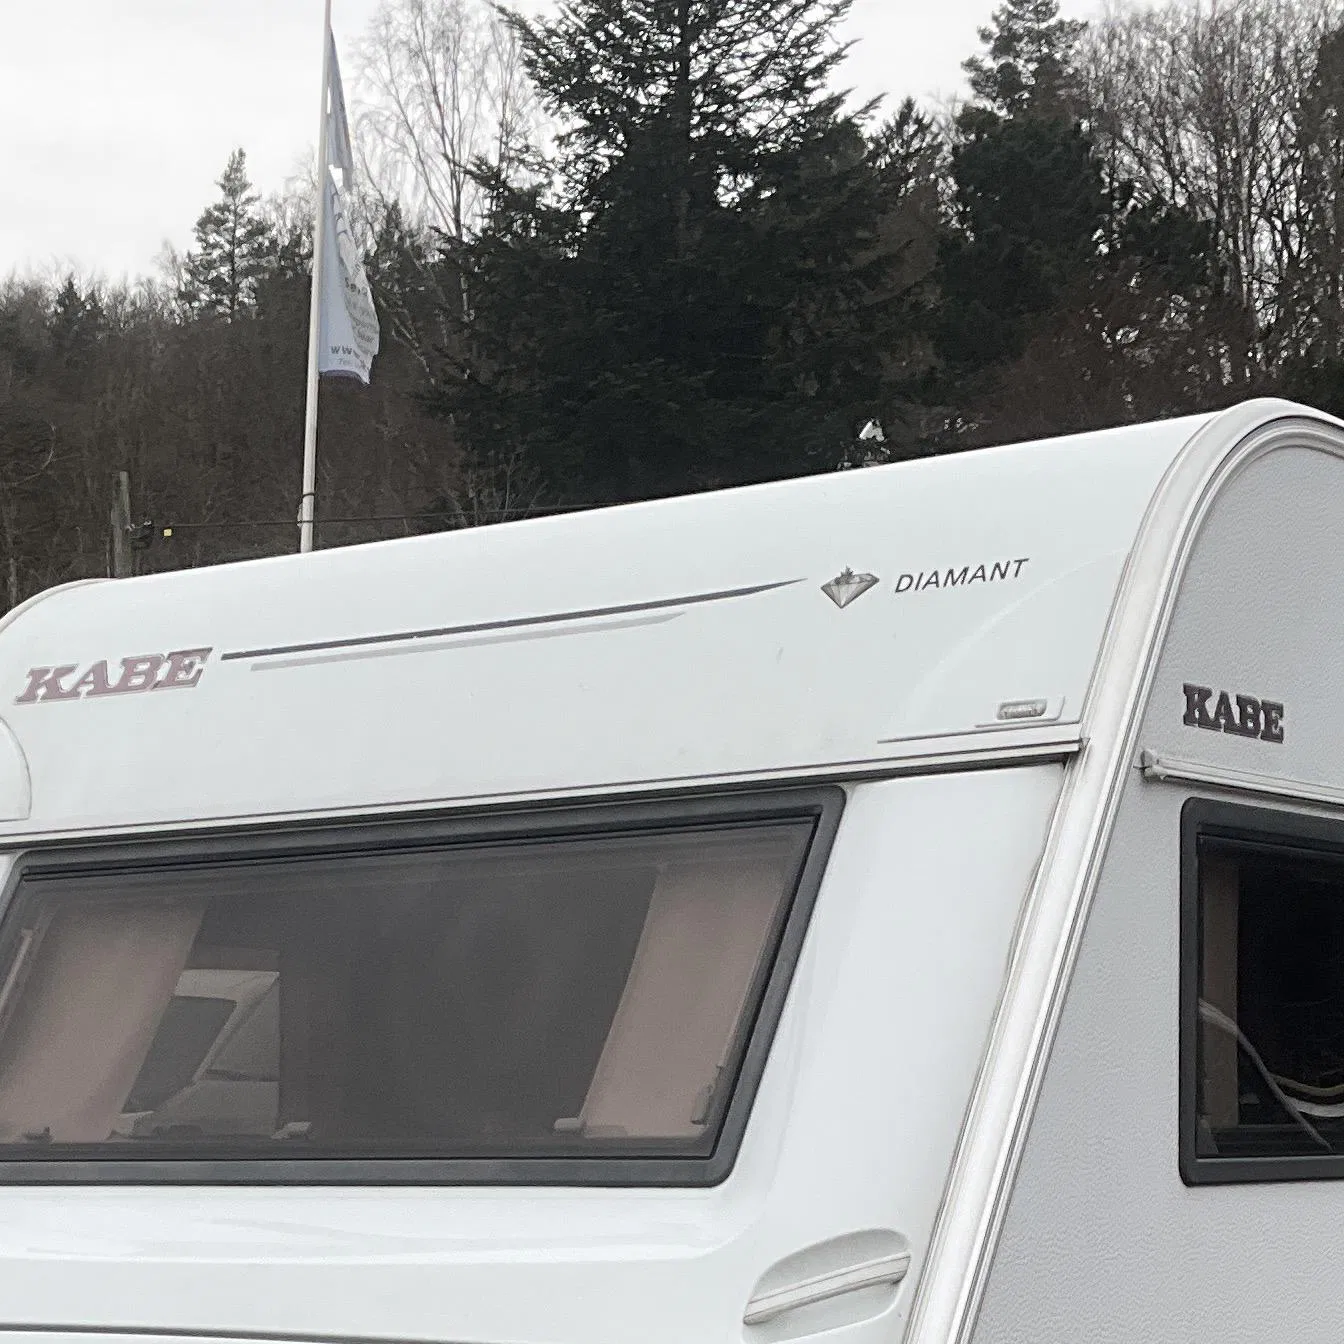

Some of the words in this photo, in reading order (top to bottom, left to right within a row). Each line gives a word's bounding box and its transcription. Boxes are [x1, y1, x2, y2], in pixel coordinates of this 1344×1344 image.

[894, 557, 1030, 594] DIAMANT
[14, 647, 214, 705] KABE
[1182, 682, 1284, 744] KABE
